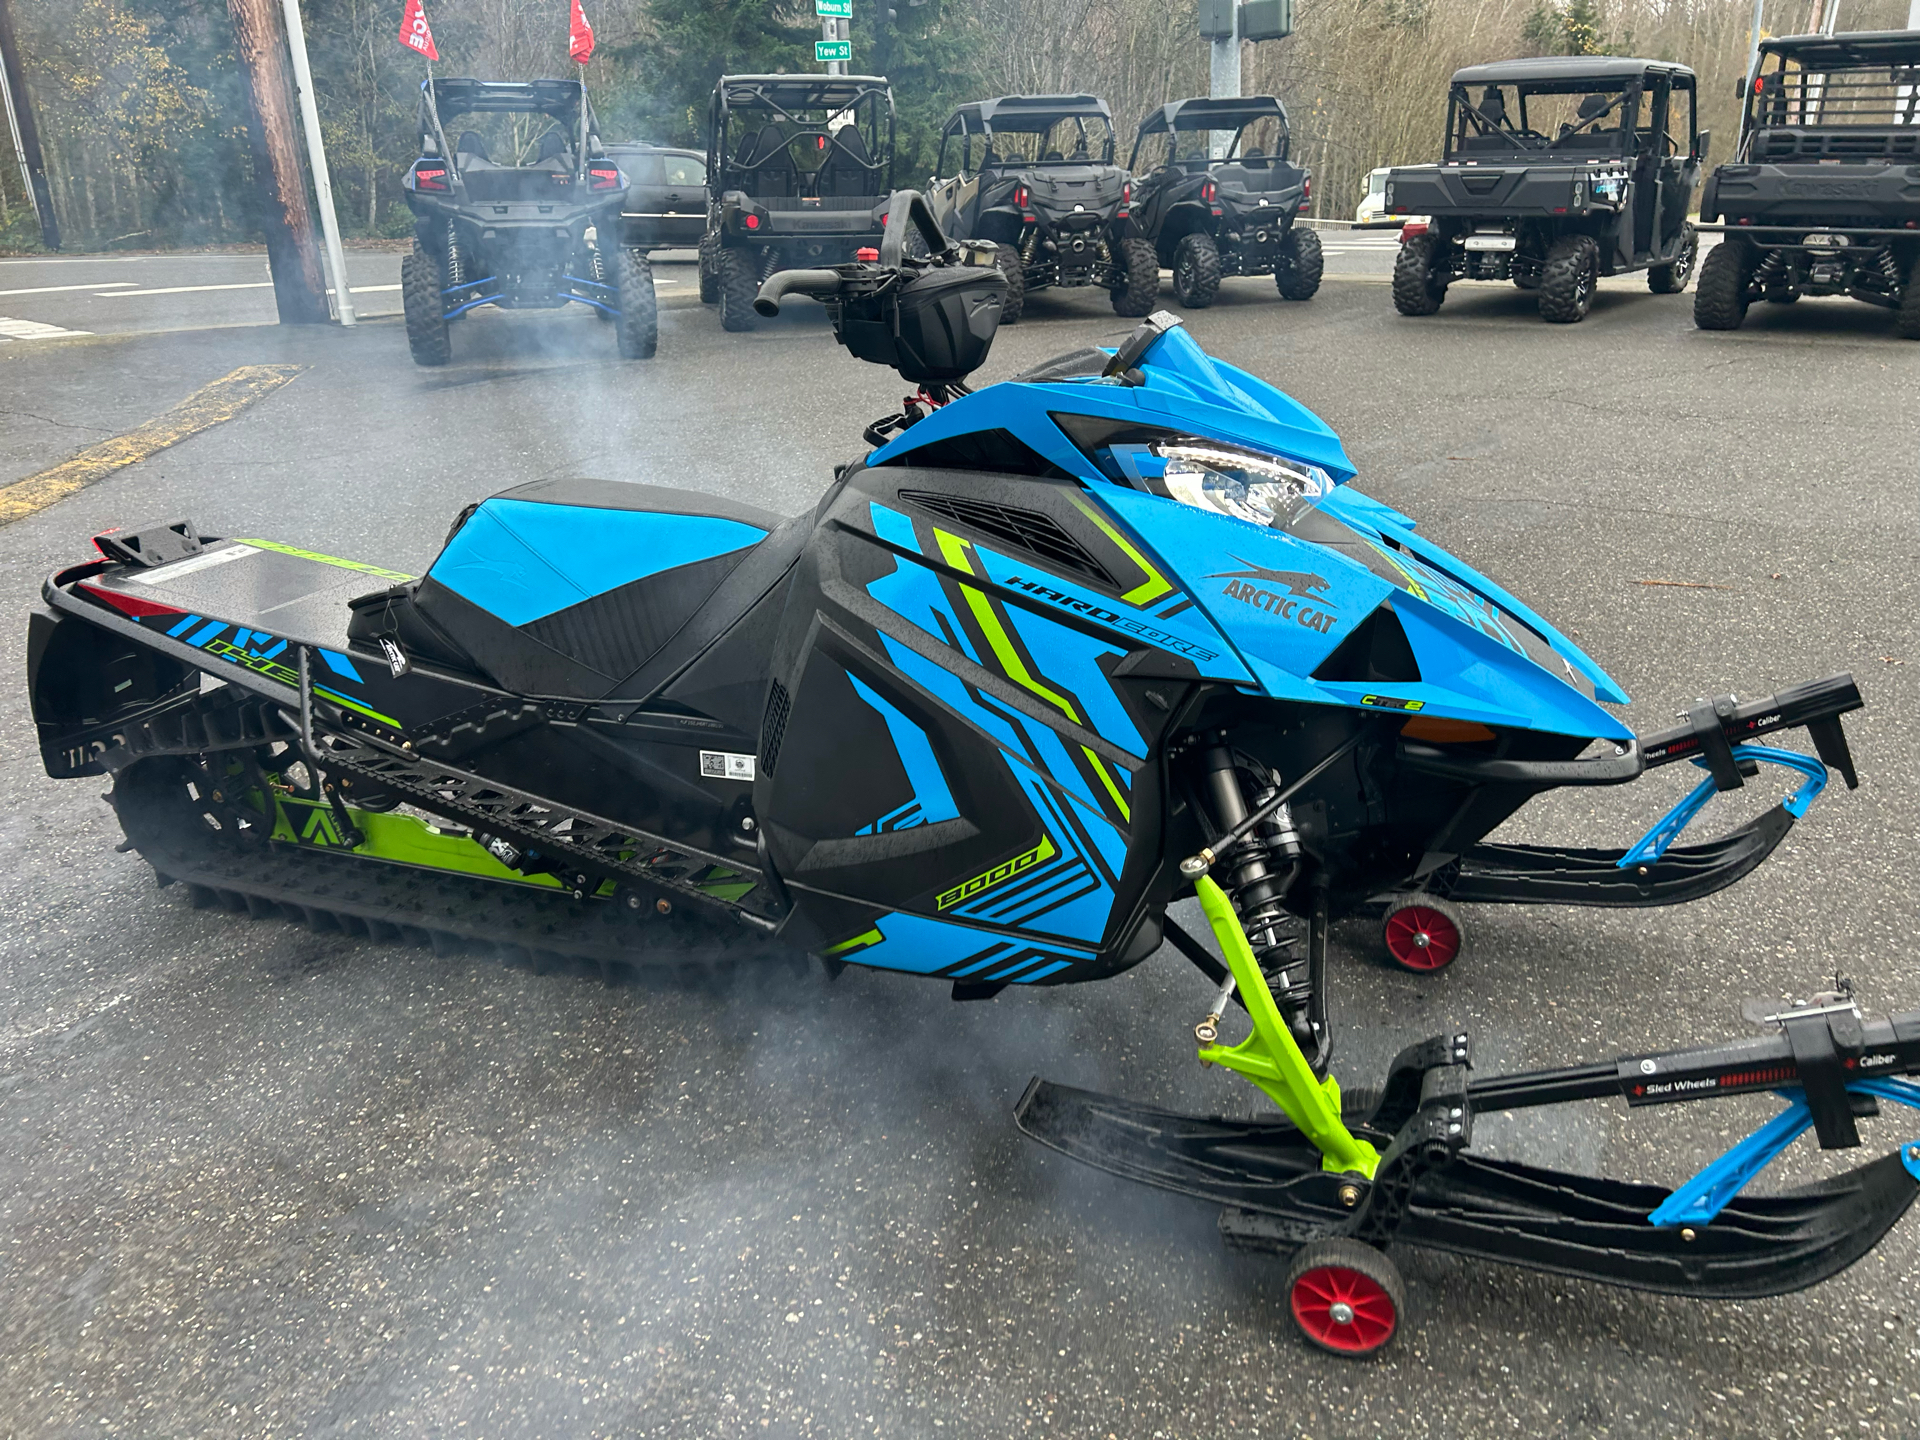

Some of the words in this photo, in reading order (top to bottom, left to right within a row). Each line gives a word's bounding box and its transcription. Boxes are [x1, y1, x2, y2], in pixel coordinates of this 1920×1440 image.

[817, 1, 842, 13] Woburn
[843, 2, 851, 14] St
[818, 46, 837, 57] Yew
[839, 45, 849, 56] St
[792, 218, 852, 230] Kawasaki
[1222, 579, 1298, 620] ARCTIC
[1297, 607, 1338, 635] CAT
[1004, 576, 1220, 662] HARDCORE
[1757, 714, 1782, 727] Caliber
[1644, 749, 1666, 761] heels
[940, 849, 1039, 908] 8000
[1859, 1053, 1896, 1068] Caliber
[1646, 1082, 1672, 1095] Sled
[1674, 1077, 1717, 1091] Wheels
